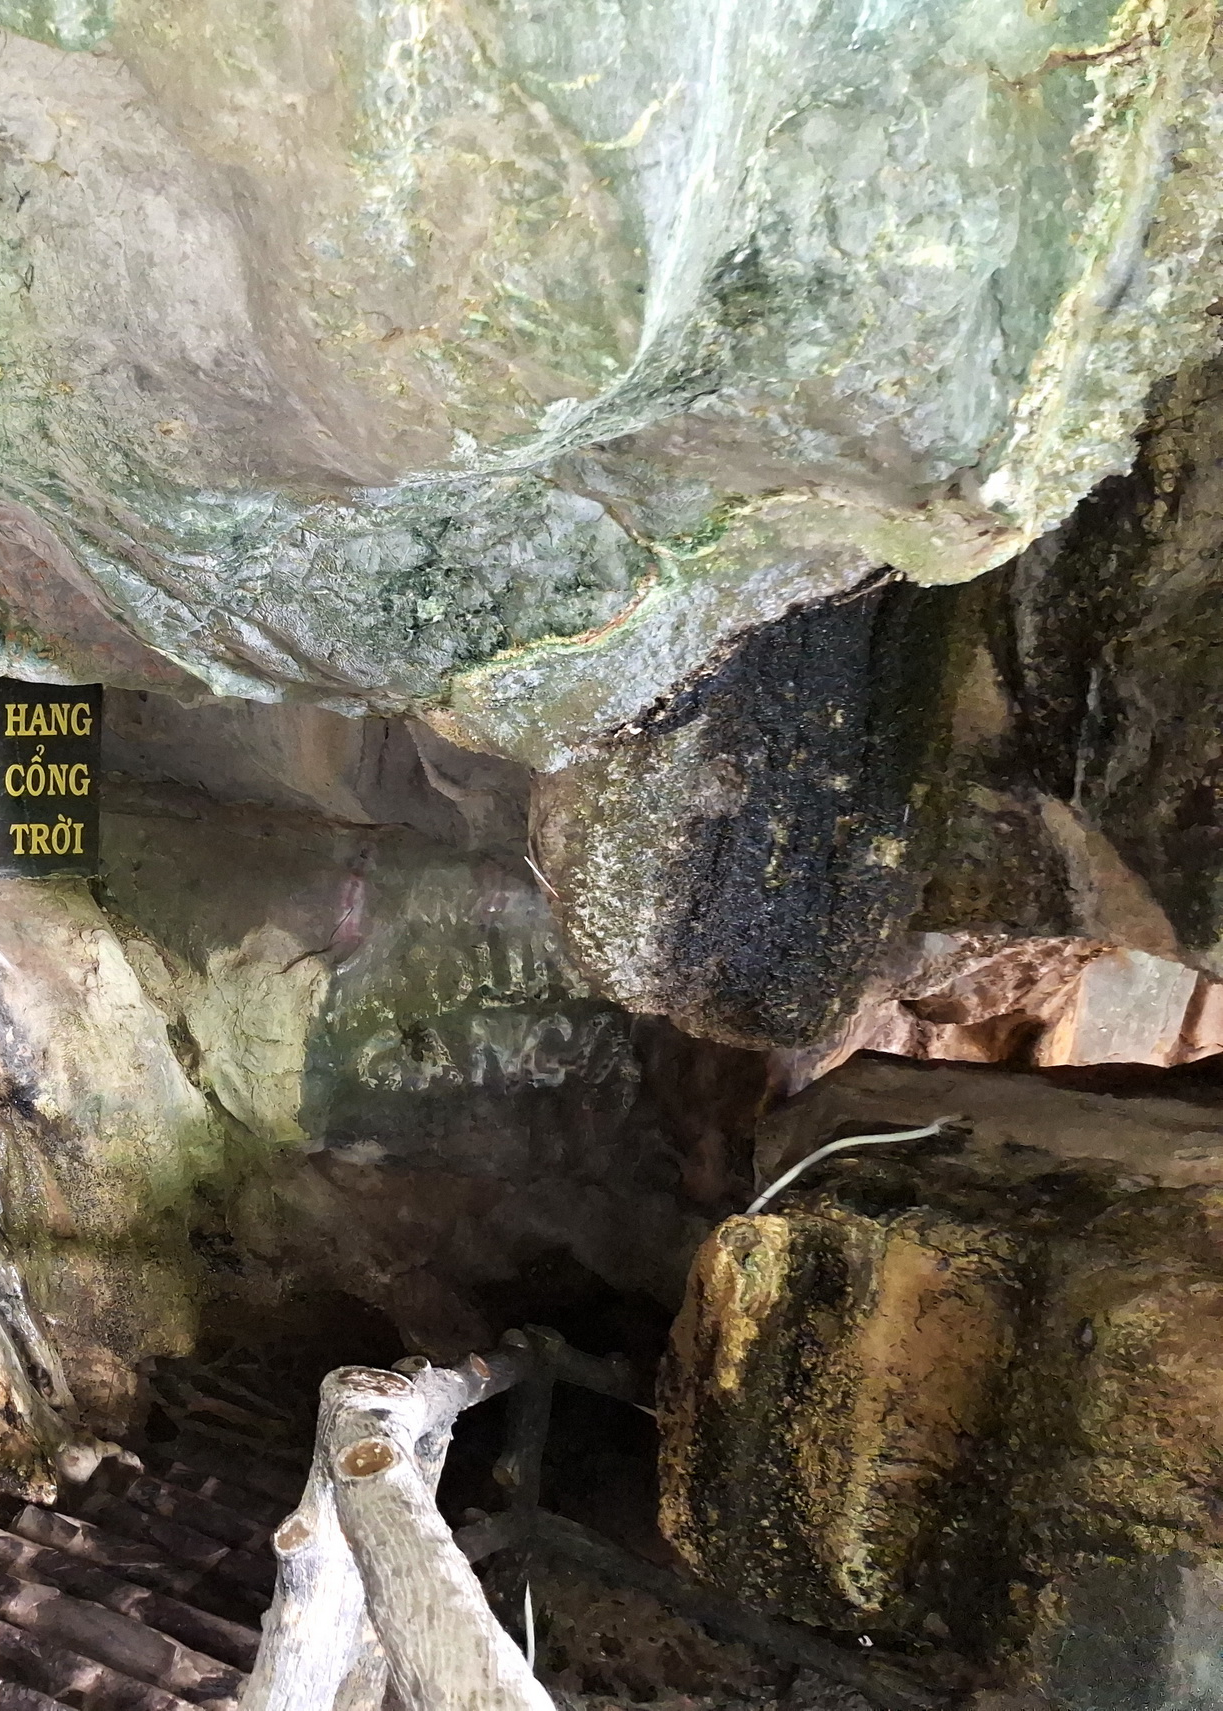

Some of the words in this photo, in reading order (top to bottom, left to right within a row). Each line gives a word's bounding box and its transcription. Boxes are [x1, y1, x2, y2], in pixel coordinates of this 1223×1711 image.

[5, 702, 92, 737] HANG
[5, 744, 91, 797] CỔNG
[9, 813, 84, 855] TRỜI
